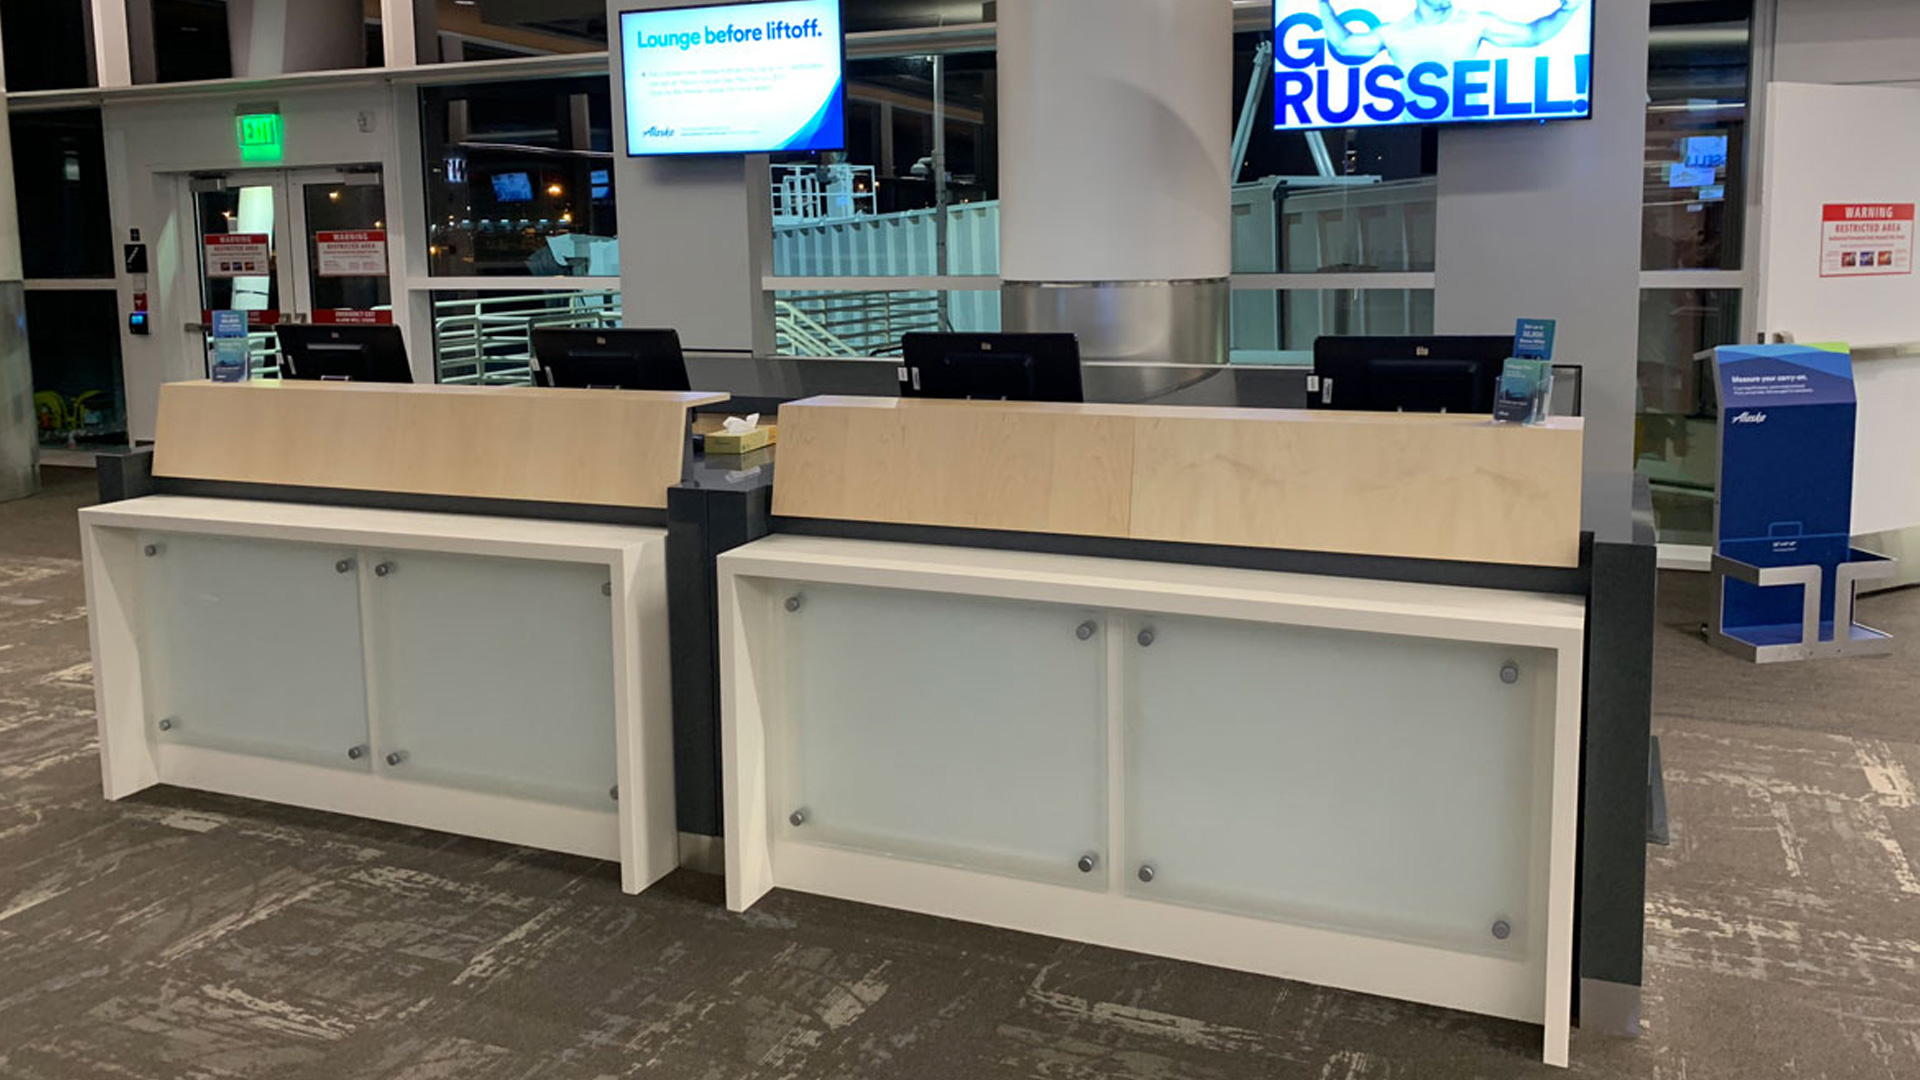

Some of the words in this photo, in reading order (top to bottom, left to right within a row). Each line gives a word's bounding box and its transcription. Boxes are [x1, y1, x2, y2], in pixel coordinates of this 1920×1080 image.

[637, 31, 701, 50] Lounge
[704, 24, 762, 44] before
[766, 18, 823, 40] liftoff.
[1275, 9, 1382, 69] GO
[1274, 54, 1590, 125] RUSSELL!
[1845, 206, 1894, 219] WARNING
[1835, 223, 1880, 233] RESTRICTED
[1882, 223, 1901, 231] AREA
[1731, 375, 1760, 383] Measure
[1731, 411, 1767, 424] Alaska
